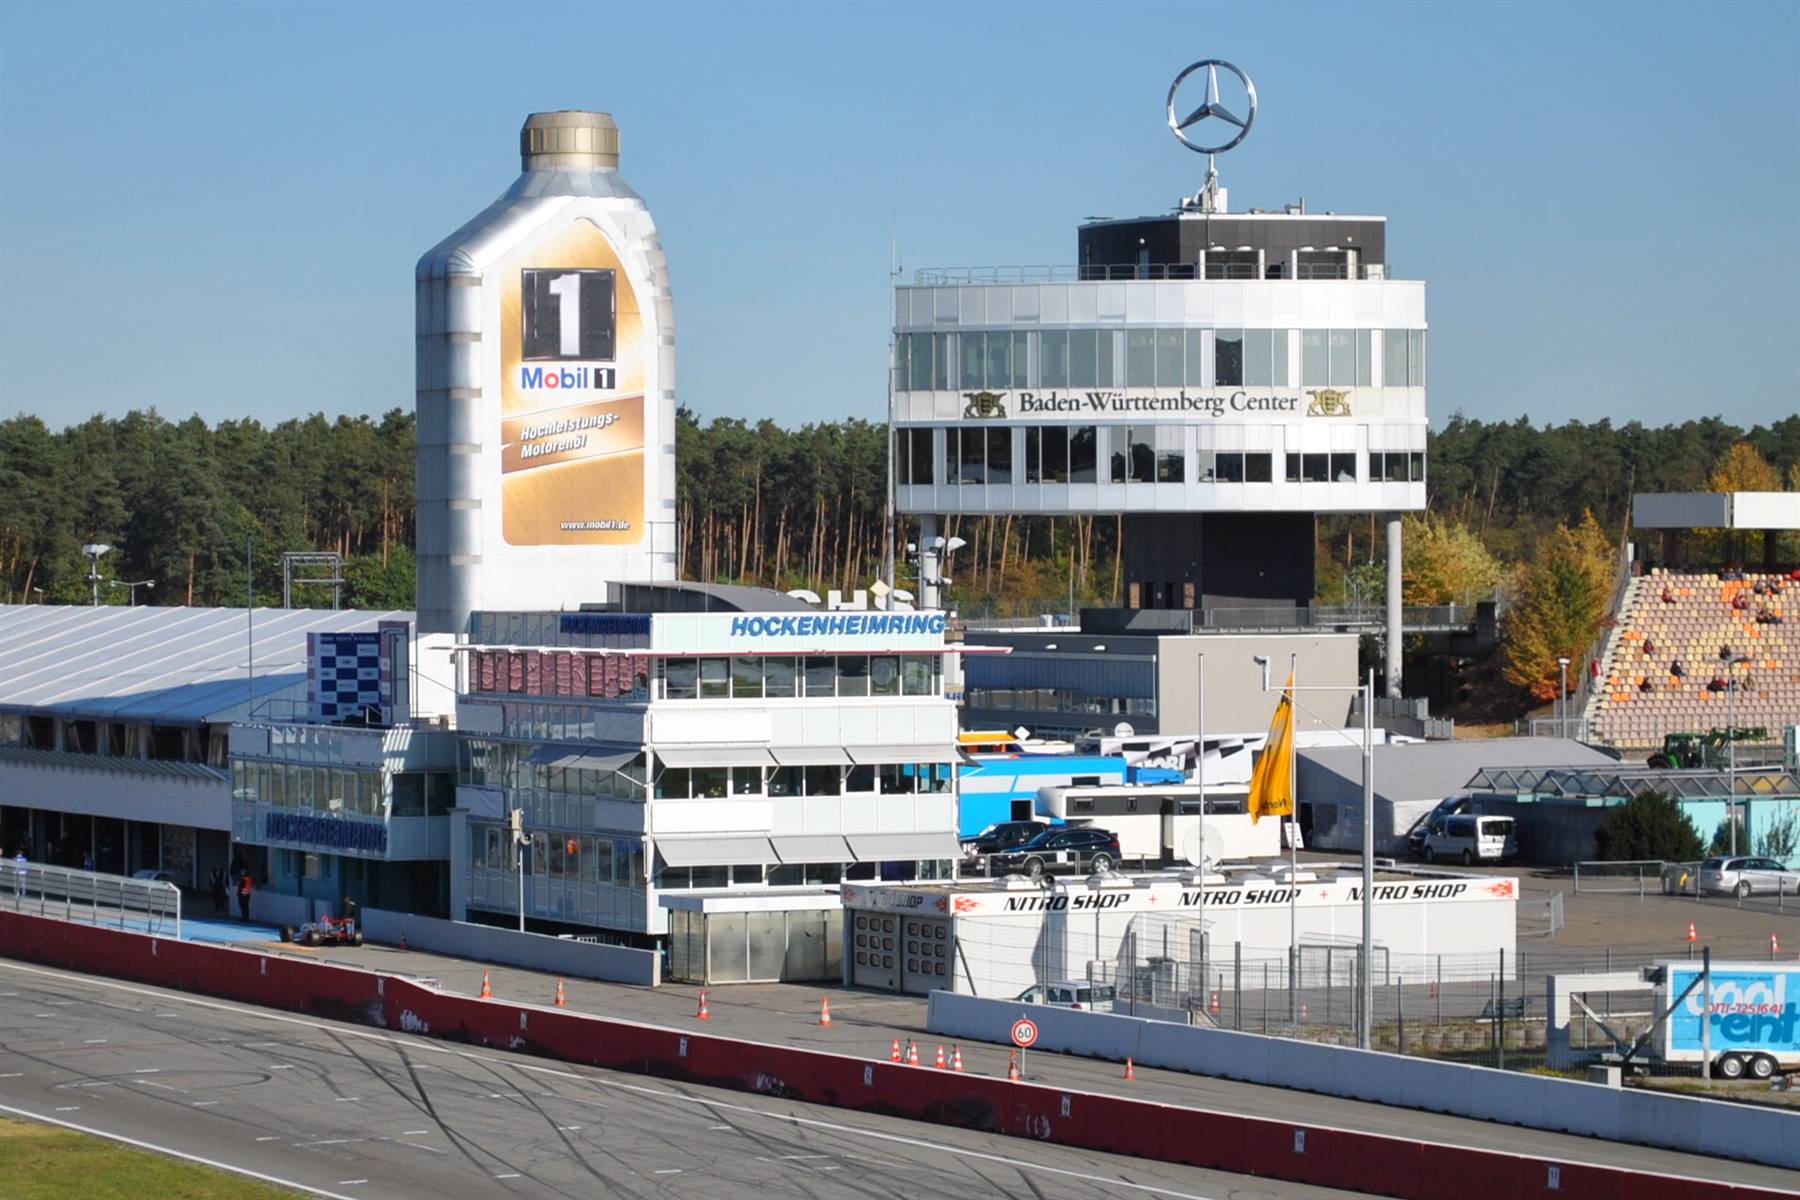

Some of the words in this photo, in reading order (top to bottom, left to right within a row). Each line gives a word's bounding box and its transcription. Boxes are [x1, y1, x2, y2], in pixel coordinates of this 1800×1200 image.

[549, 272, 580, 355] 1
[521, 367, 588, 389] Mobil
[1019, 391, 1225, 417] Baden-Württemberg
[1230, 391, 1298, 411] Center
[521, 412, 619, 440] Hochleistungs-
[521, 434, 588, 459] Motorenöl
[560, 519, 631, 531] www.mobil1.de
[731, 615, 945, 636] HOCKENHEIMRING
[1004, 896, 1069, 911] NITRO
[1071, 893, 1130, 910] SHOP
[1178, 890, 1242, 906] NITRO
[1244, 888, 1301, 904] SHOP
[1347, 886, 1409, 901] NTRO
[1411, 884, 1467, 899] SHOP
[1018, 1027, 1031, 1038] 60
[1698, 1002, 1800, 1044] rent
